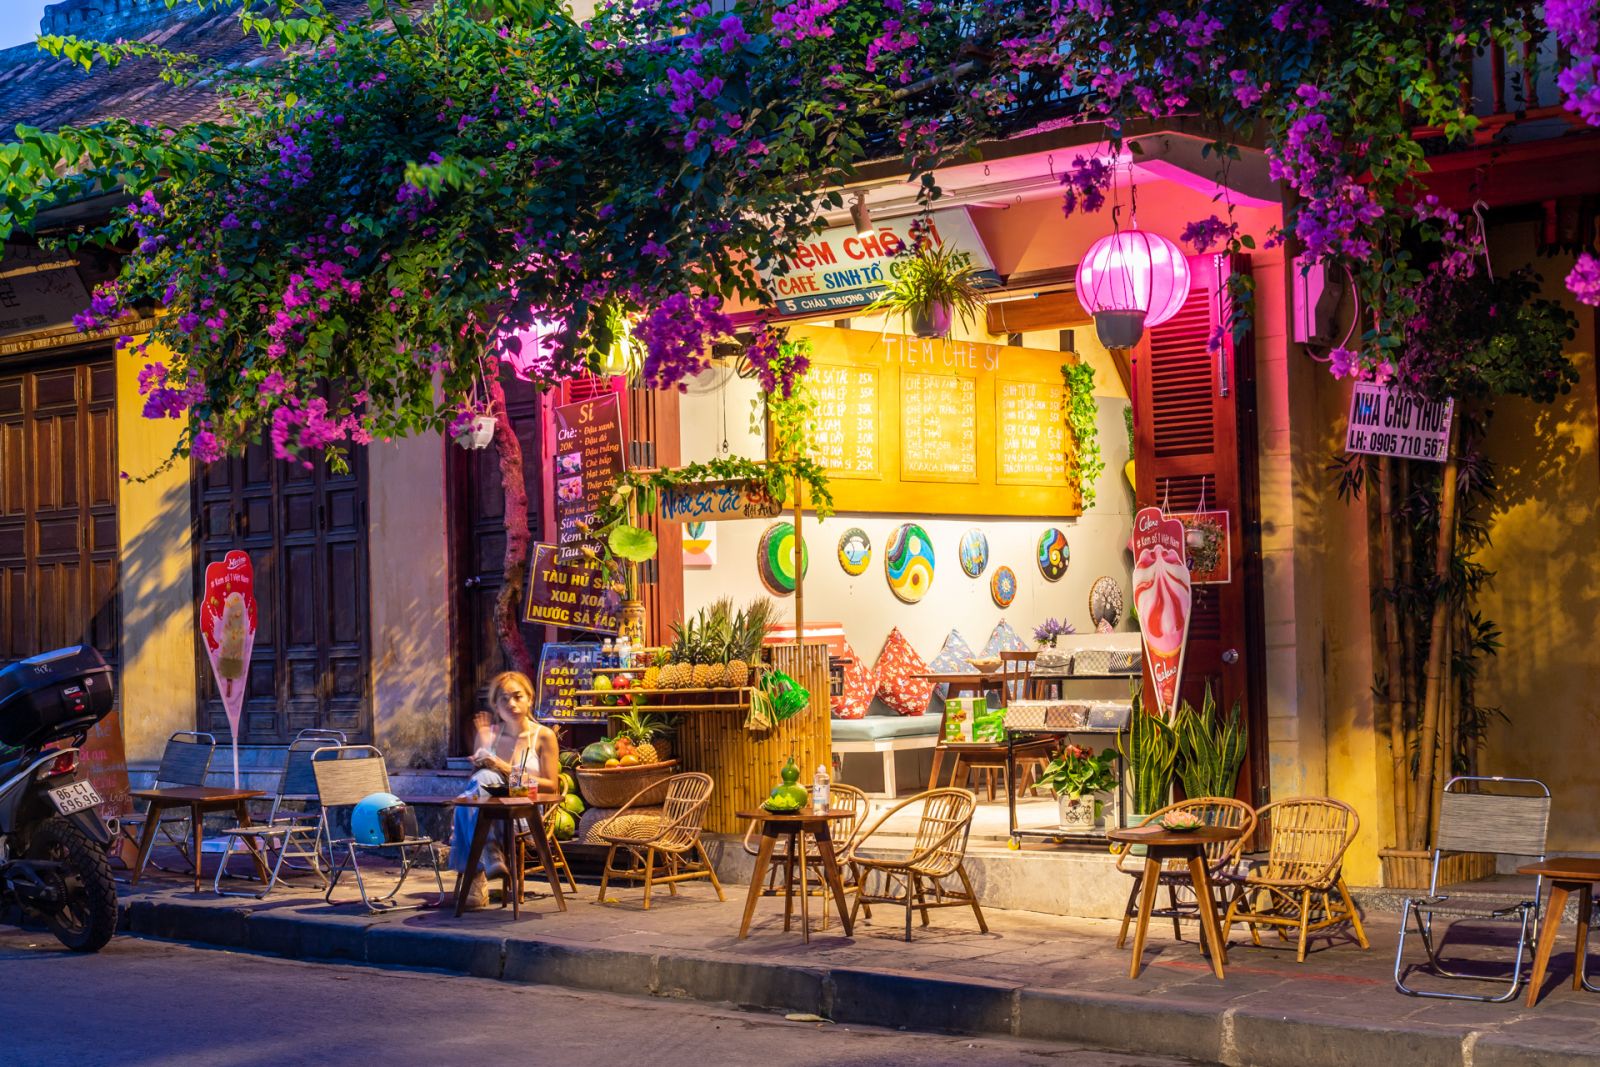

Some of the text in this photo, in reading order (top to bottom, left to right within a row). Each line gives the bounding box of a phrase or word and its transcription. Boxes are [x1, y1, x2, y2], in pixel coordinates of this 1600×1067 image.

[823, 269, 862, 290] SINH
[786, 299, 798, 312] 5
[578, 403, 594, 424] Si
[1384, 395, 1413, 430] CHO
[1349, 430, 1367, 450] LH:
[1369, 432, 1398, 453] 0905
[1400, 435, 1422, 456] 710
[560, 516, 581, 531] Sin
[561, 532, 582, 544] Kem
[550, 589, 577, 604] XOA
[532, 605, 570, 621] NƯỚC
[56, 783, 88, 800] 86-C1
[60, 793, 98, 812] 696.96
